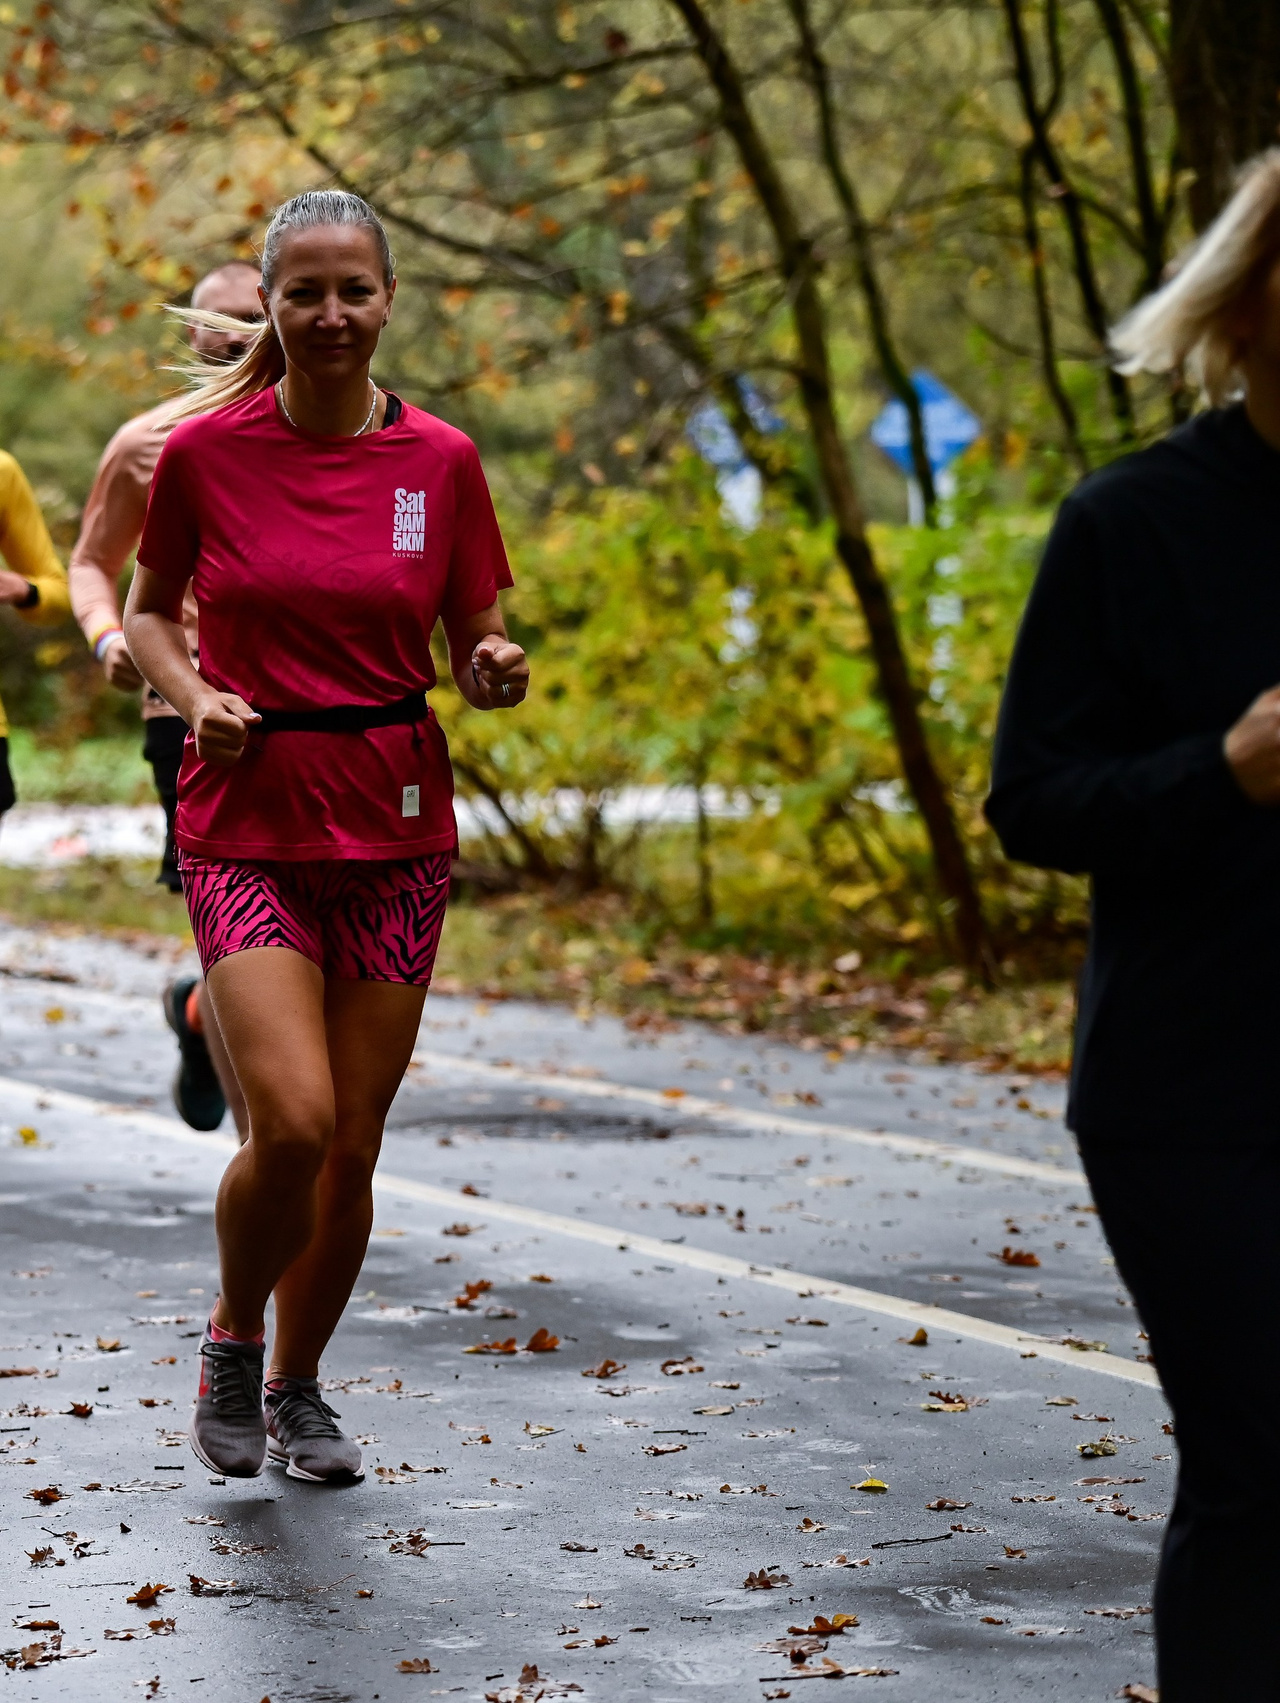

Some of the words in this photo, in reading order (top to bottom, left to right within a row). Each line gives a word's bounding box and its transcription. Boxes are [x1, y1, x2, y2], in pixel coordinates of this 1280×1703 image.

[394, 487, 426, 513] Sat
[393, 512, 426, 532] 9AM
[392, 531, 425, 552] 5KM
